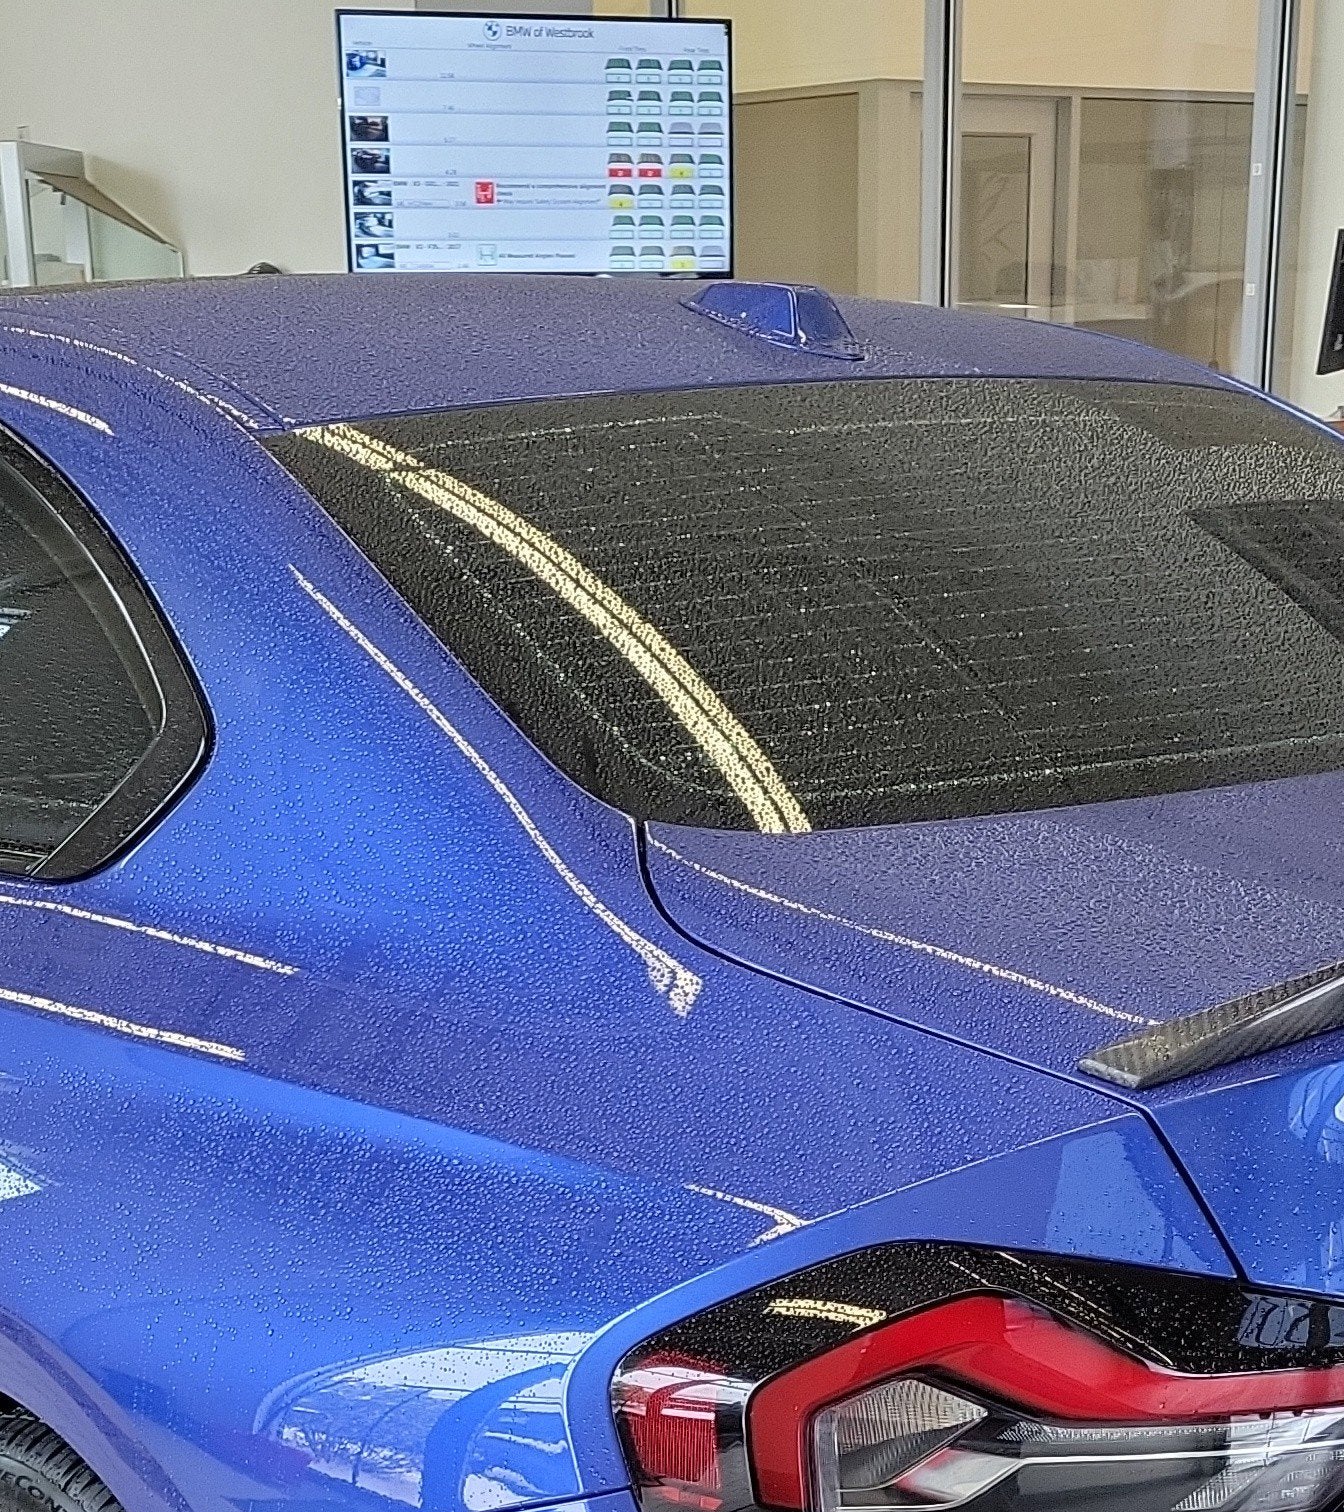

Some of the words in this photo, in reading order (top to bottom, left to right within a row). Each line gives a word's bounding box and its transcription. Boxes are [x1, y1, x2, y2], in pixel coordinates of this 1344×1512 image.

[506, 25, 531, 37] BMW
[534, 26, 544, 38] of
[545, 27, 595, 39] Westbrook
